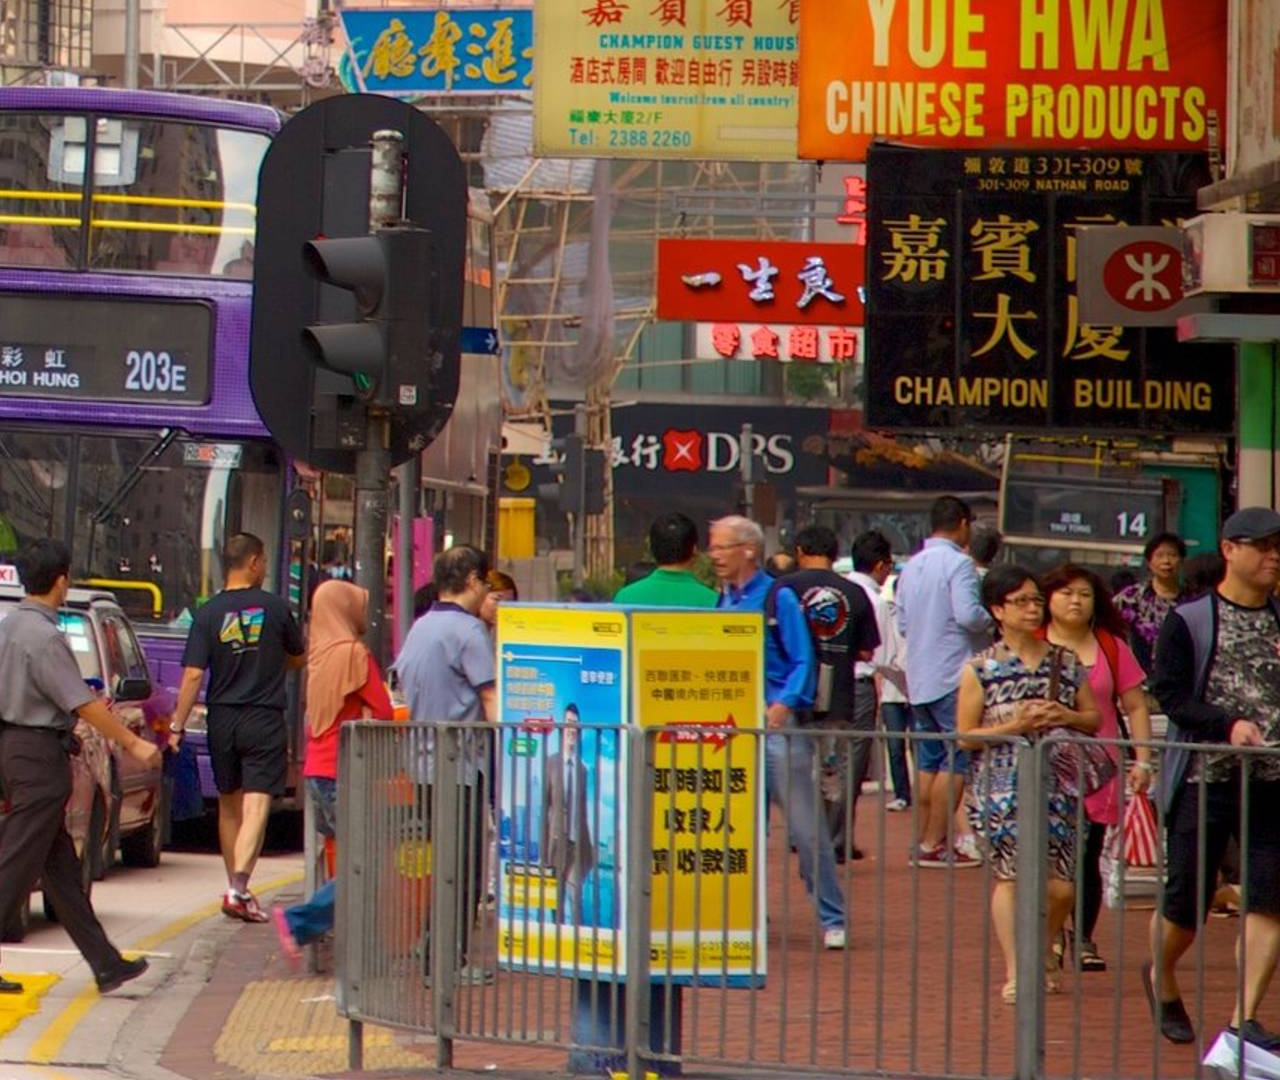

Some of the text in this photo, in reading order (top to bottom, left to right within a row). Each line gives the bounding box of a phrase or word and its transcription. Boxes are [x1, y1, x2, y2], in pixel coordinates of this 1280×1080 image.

[599, 34, 800, 52] CHAMPION GUEST HOUS
[570, 56, 647, 85] 酒店式房間
[655, 58, 733, 86] 歡迎自由行
[608, 91, 658, 105] Welcome
[826, 81, 1206, 142] CHINESE PRODUCTS
[609, 129, 648, 147] 2388
[651, 129, 691, 147] 2260
[977, 179, 1130, 191] 301-309 NATHAN ROAD
[682, 256, 865, 308] 一生良
[709, 324, 858, 361] 零食超市
[0, 346, 66, 368] 彩虹
[33, 372, 80, 388] HUNG
[125, 351, 187, 391] 203E
[894, 376, 1212, 411] CHAMPION BUILDING
[1117, 511, 1148, 537] 14
[664, 807, 736, 834] 收款人
